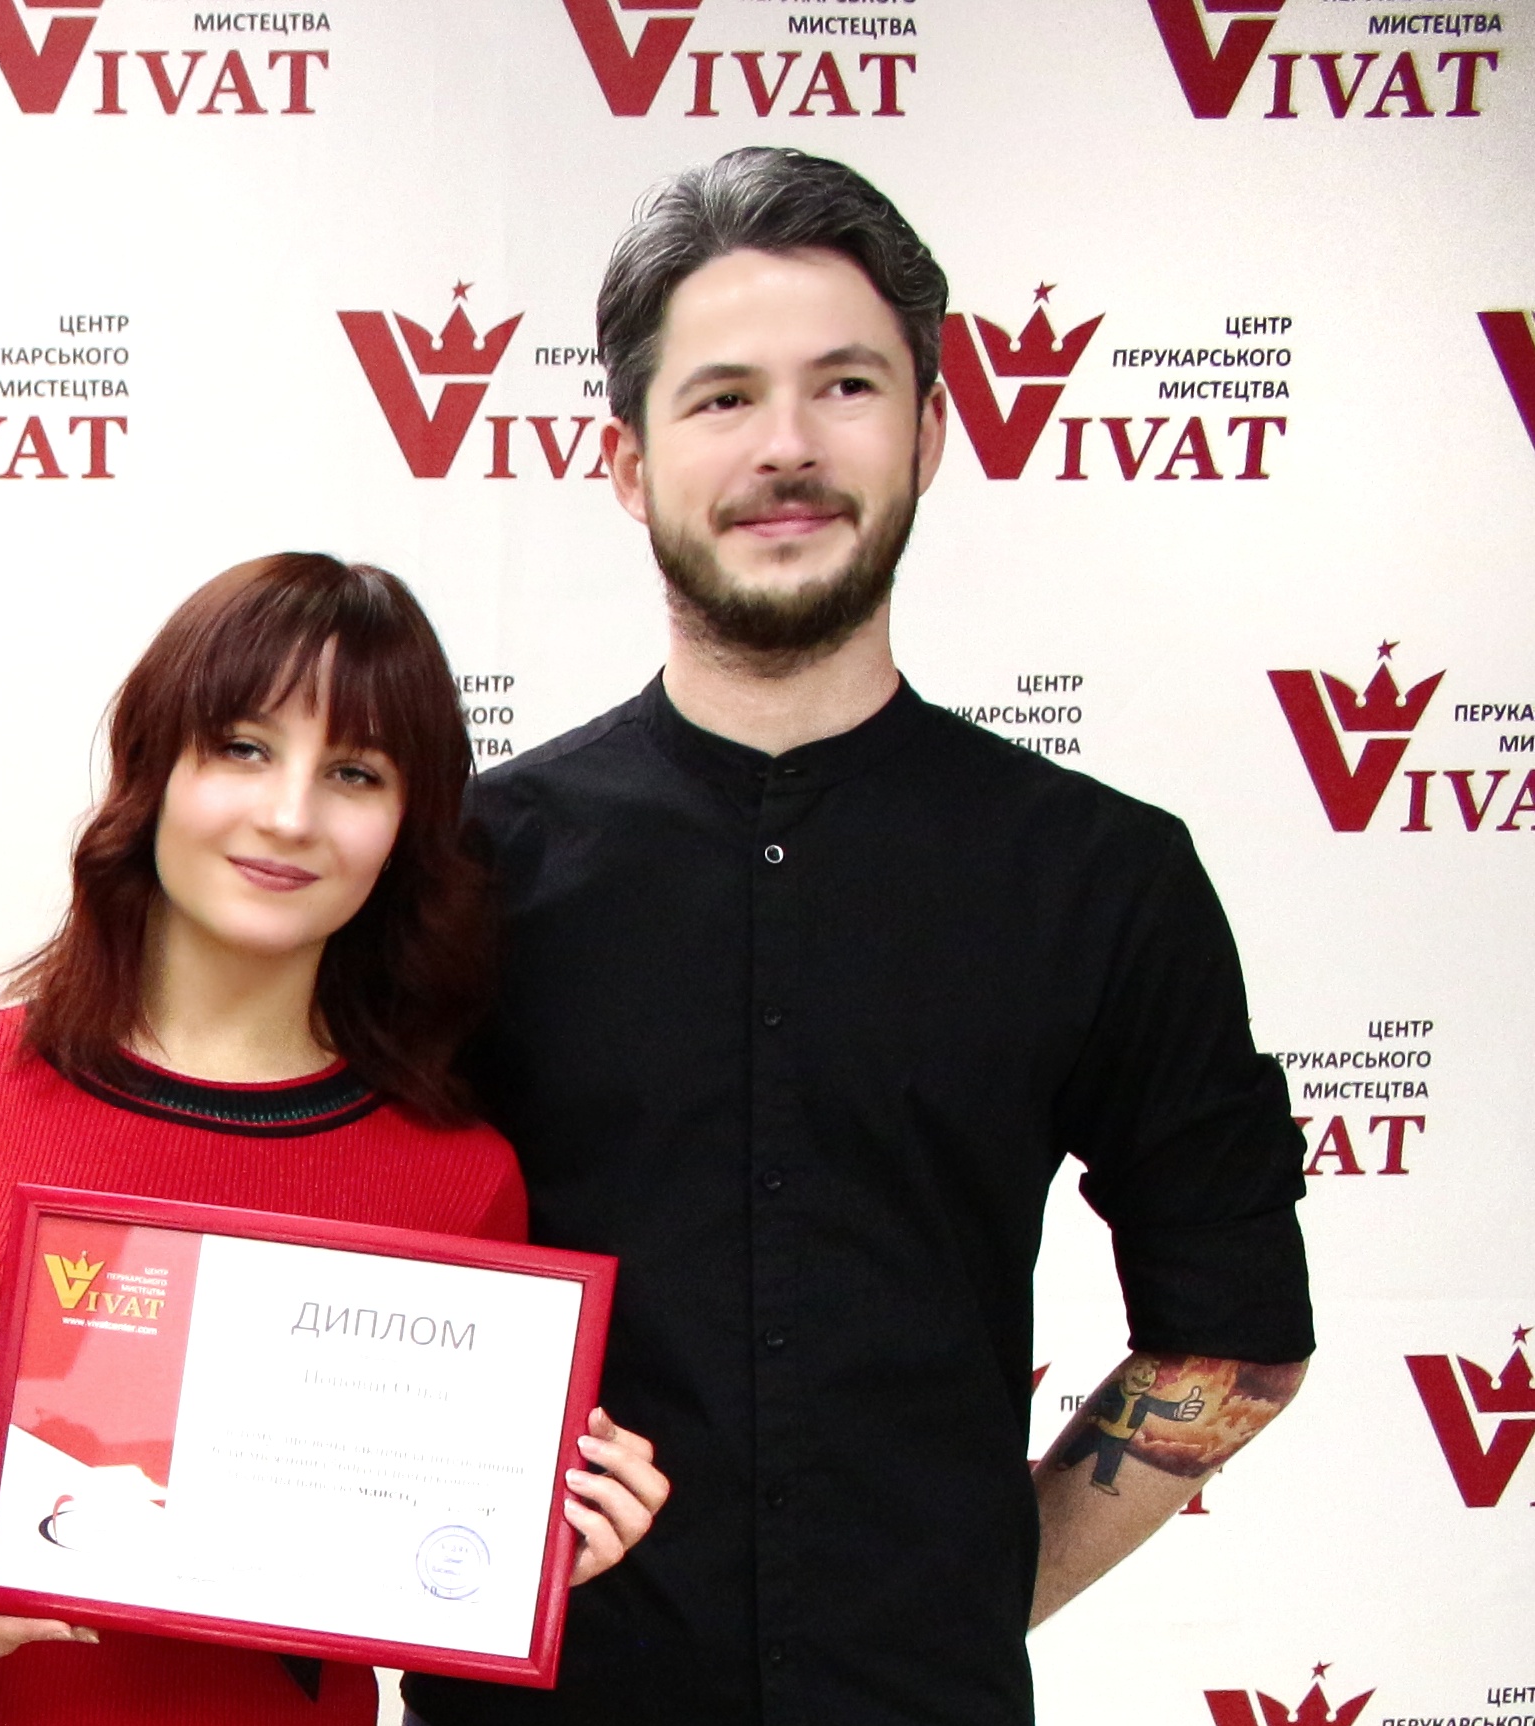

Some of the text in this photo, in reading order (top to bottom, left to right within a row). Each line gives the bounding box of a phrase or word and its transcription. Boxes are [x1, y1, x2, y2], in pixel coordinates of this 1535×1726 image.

[194, 12, 331, 36] МИСТЕЦТВА
[788, 15, 917, 39] МИСТЕЦТВА
[1368, 11, 1503, 38] МИСТЕЦТВА
[564, 0, 918, 118] VIVAT
[1152, 0, 1500, 119] VIVAT
[59, 315, 130, 337] ЦЕНТР
[1225, 316, 1293, 339] ЦЕНТР
[1112, 348, 1292, 368] ПЕРУКАРСЬКОГО
[336, 304, 612, 481] VIV
[937, 304, 1287, 482] VIVAT
[1158, 380, 1290, 403] МИСТЕЦТВА
[461, 675, 515, 695] ЕНТР
[1017, 674, 1084, 696] ЦЕНТР
[1368, 1020, 1434, 1042] ЦЕНТР
[1278, 1049, 1433, 1072] ЕРУКАРСЬКОГО
[1303, 1081, 1429, 1103] МИСТЕЦТВА
[43, 1253, 166, 1320] VIVAT
[291, 1302, 477, 1351] ДИПЛОМ
